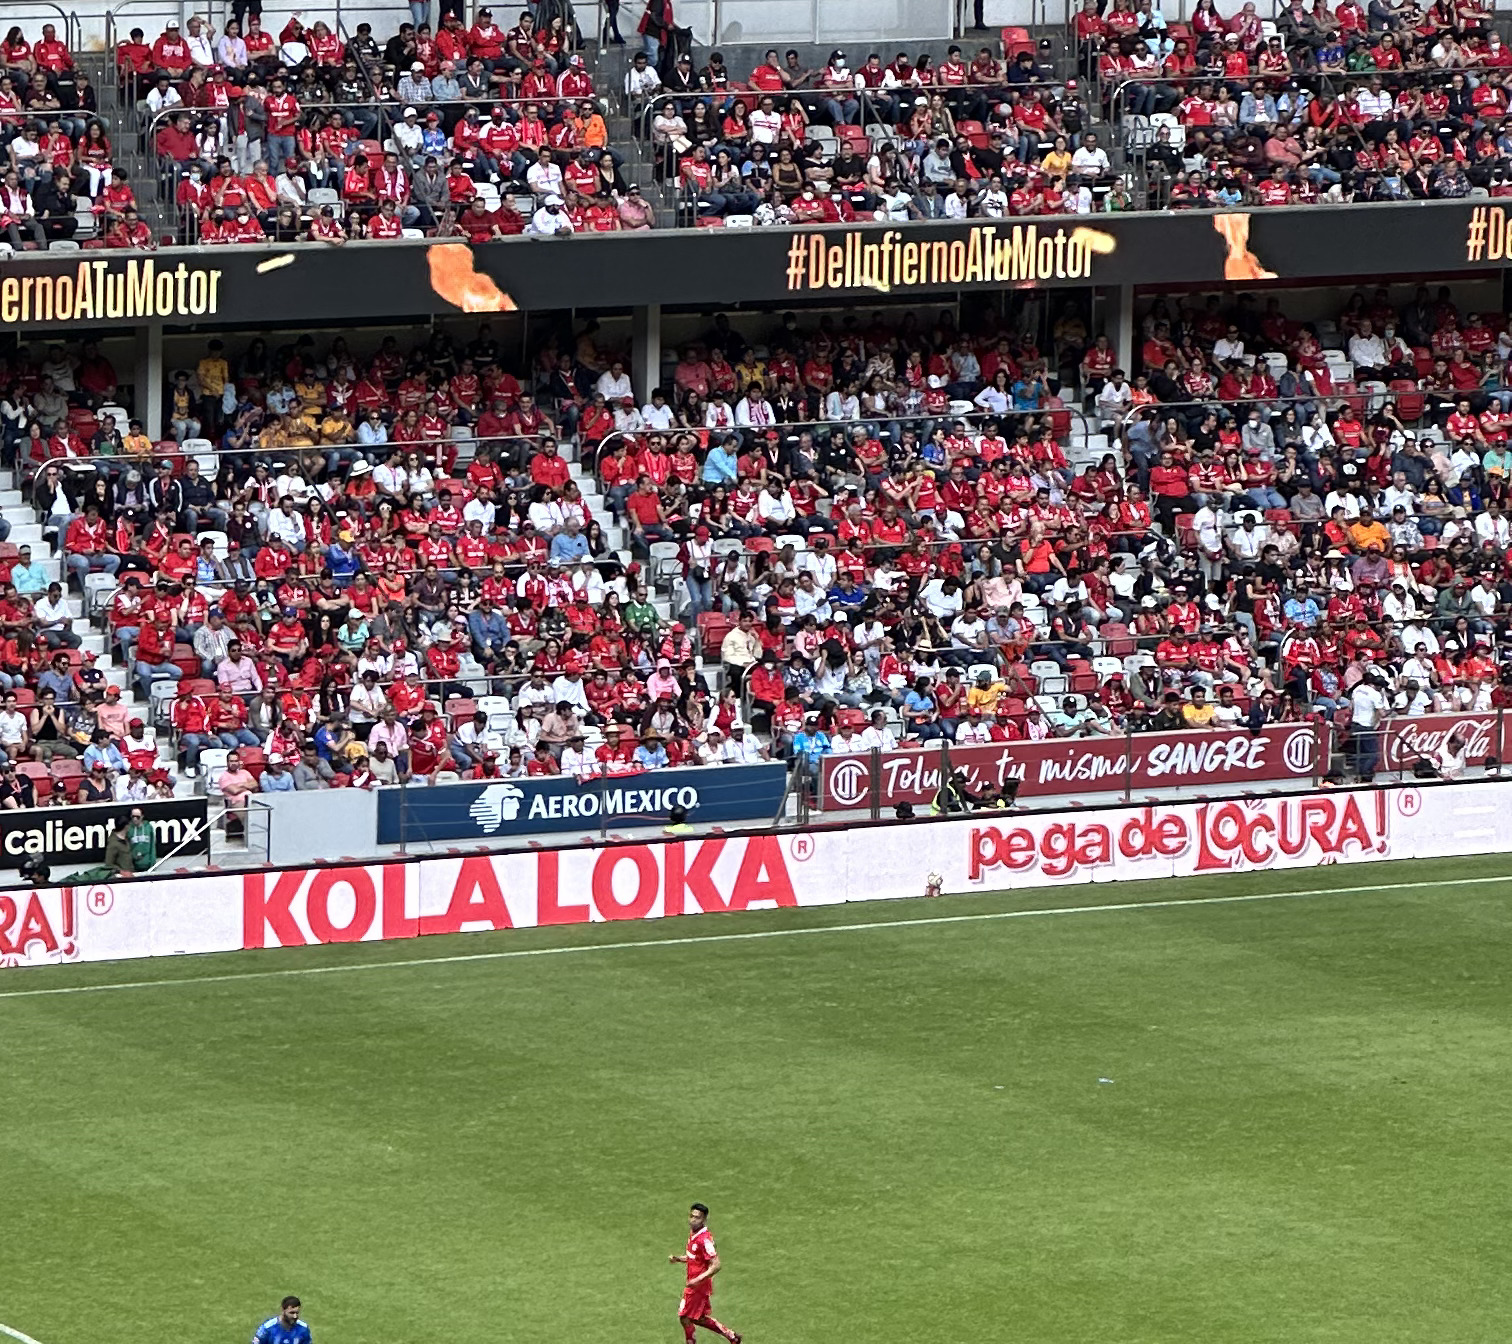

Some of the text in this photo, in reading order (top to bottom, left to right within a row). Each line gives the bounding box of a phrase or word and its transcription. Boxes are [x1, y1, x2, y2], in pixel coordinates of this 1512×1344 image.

[883, 755, 986, 798] Tolua,
[995, 748, 1028, 785] tu
[1038, 747, 1142, 784] misma
[1146, 736, 1272, 777] SANGRE
[1391, 718, 1497, 763] Coca-Cla
[528, 785, 698, 820] AEROMEXICO
[4, 817, 201, 854] calientmx
[968, 822, 1111, 880] pega
[1119, 811, 1189, 858] de
[1193, 790, 1387, 872] LOCURA!
[243, 856, 514, 949] KOLA
[536, 834, 798, 926] LOKA
